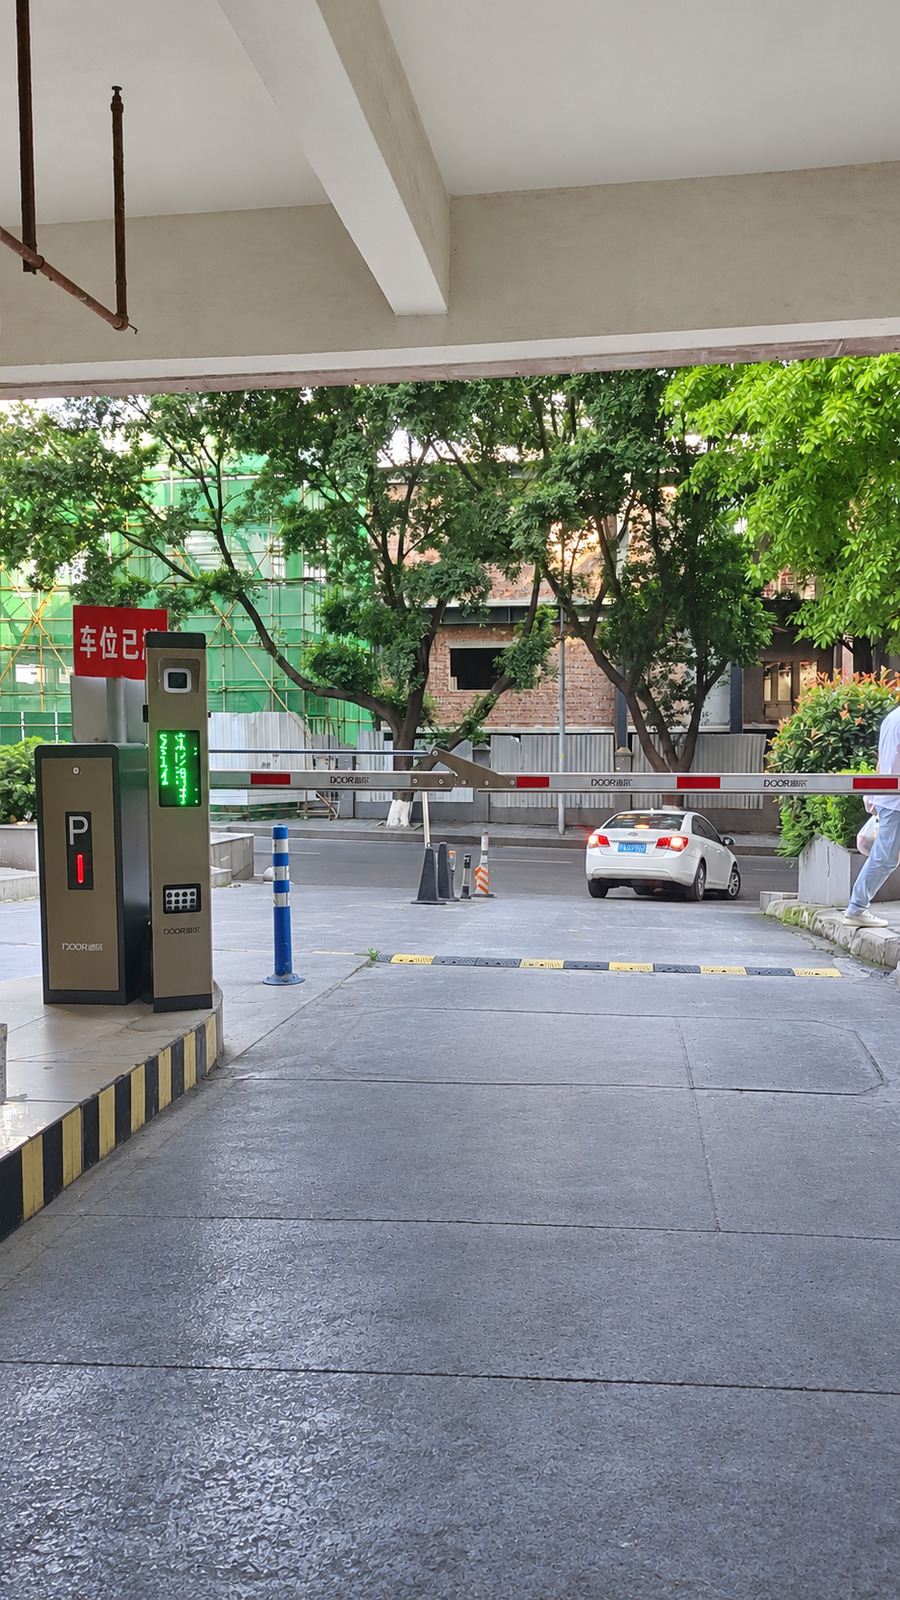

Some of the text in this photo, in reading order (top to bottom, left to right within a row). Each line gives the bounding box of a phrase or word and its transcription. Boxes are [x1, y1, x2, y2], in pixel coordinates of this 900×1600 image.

[80, 625, 158, 660] 车位已
[591, 779, 616, 787] DOOR
[764, 780, 790, 788] DOOR
[68, 816, 89, 845] P
[62, 943, 88, 951] DOOR
